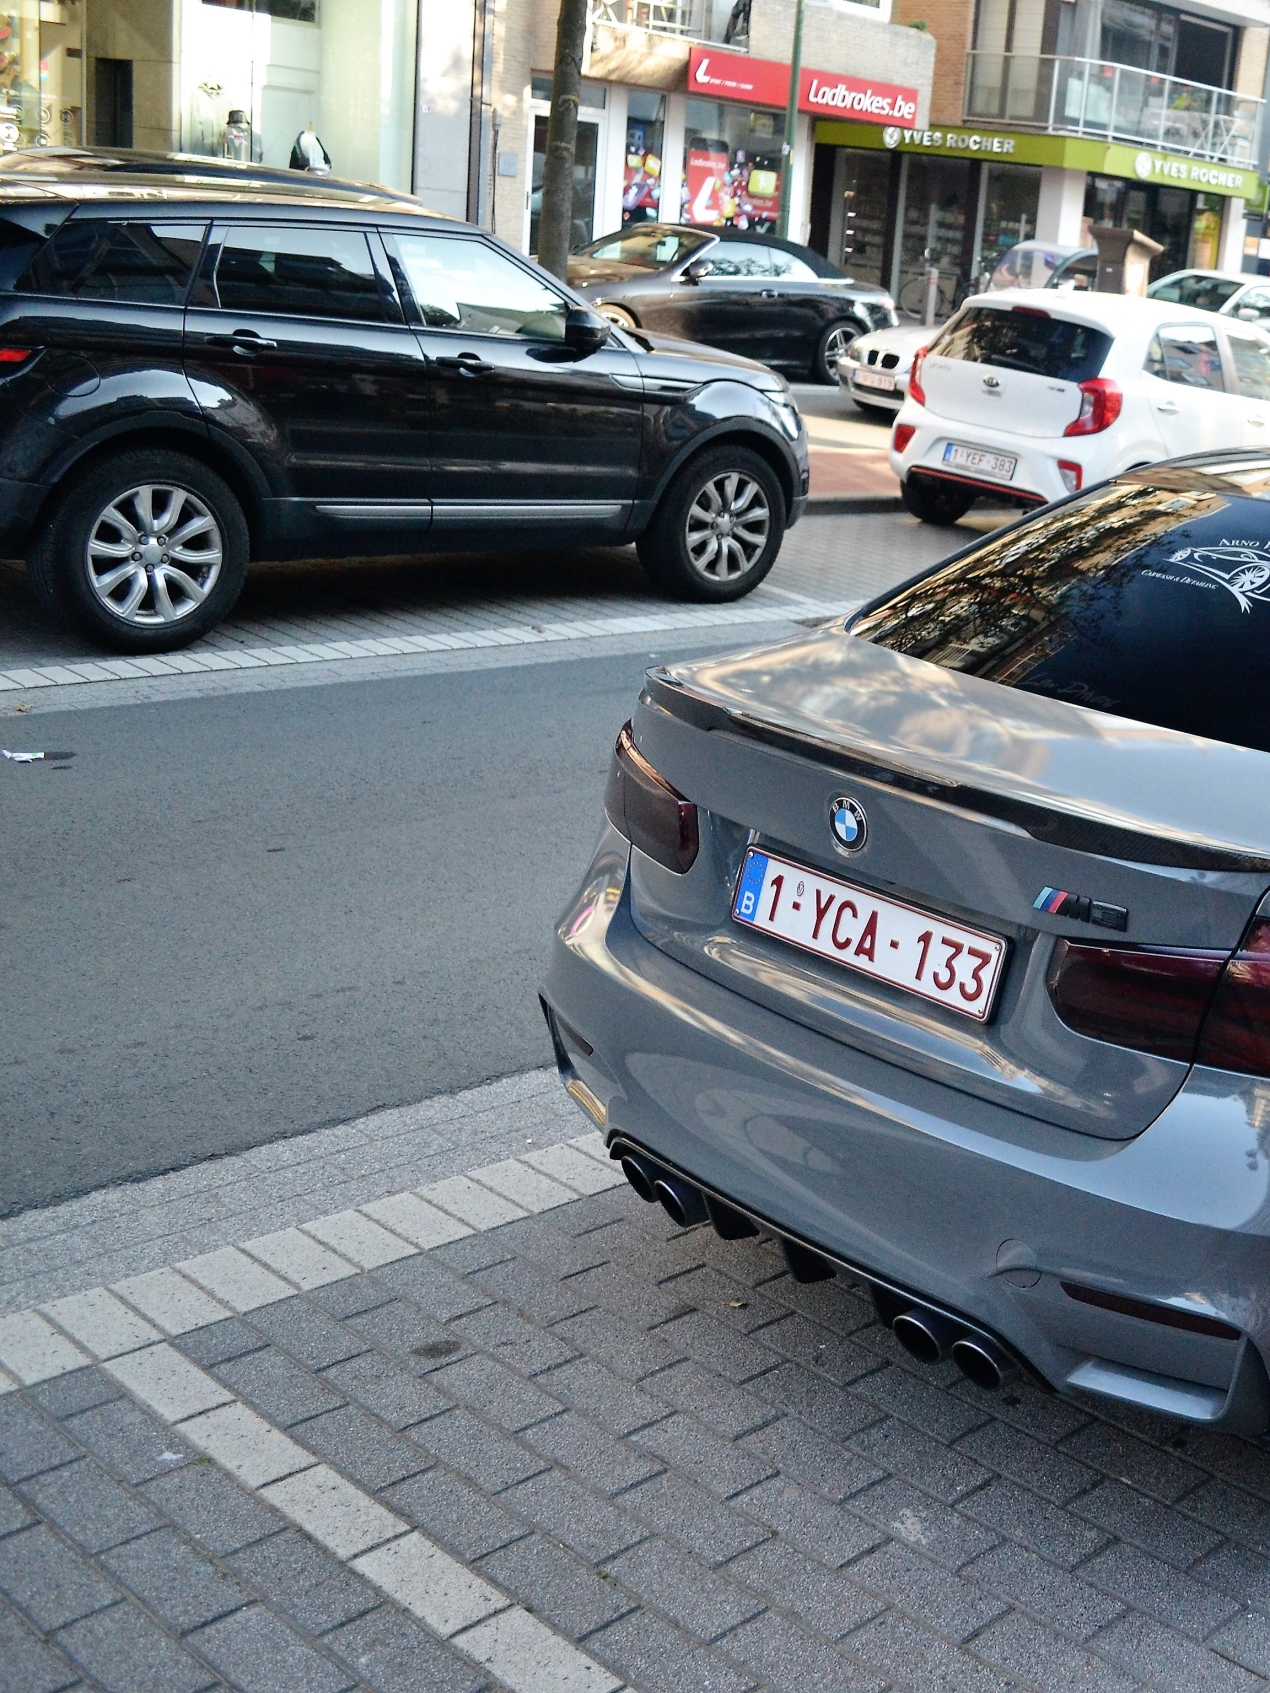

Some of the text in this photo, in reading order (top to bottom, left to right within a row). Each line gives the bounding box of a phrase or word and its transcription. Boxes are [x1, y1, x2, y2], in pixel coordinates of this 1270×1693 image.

[808, 78, 916, 120] Ladbrokes.be
[903, 129, 1015, 154] YVES ROCHER
[1153, 159, 1243, 189] YVES ROCHER
[832, 800, 862, 821] BMW
[741, 891, 755, 915] B
